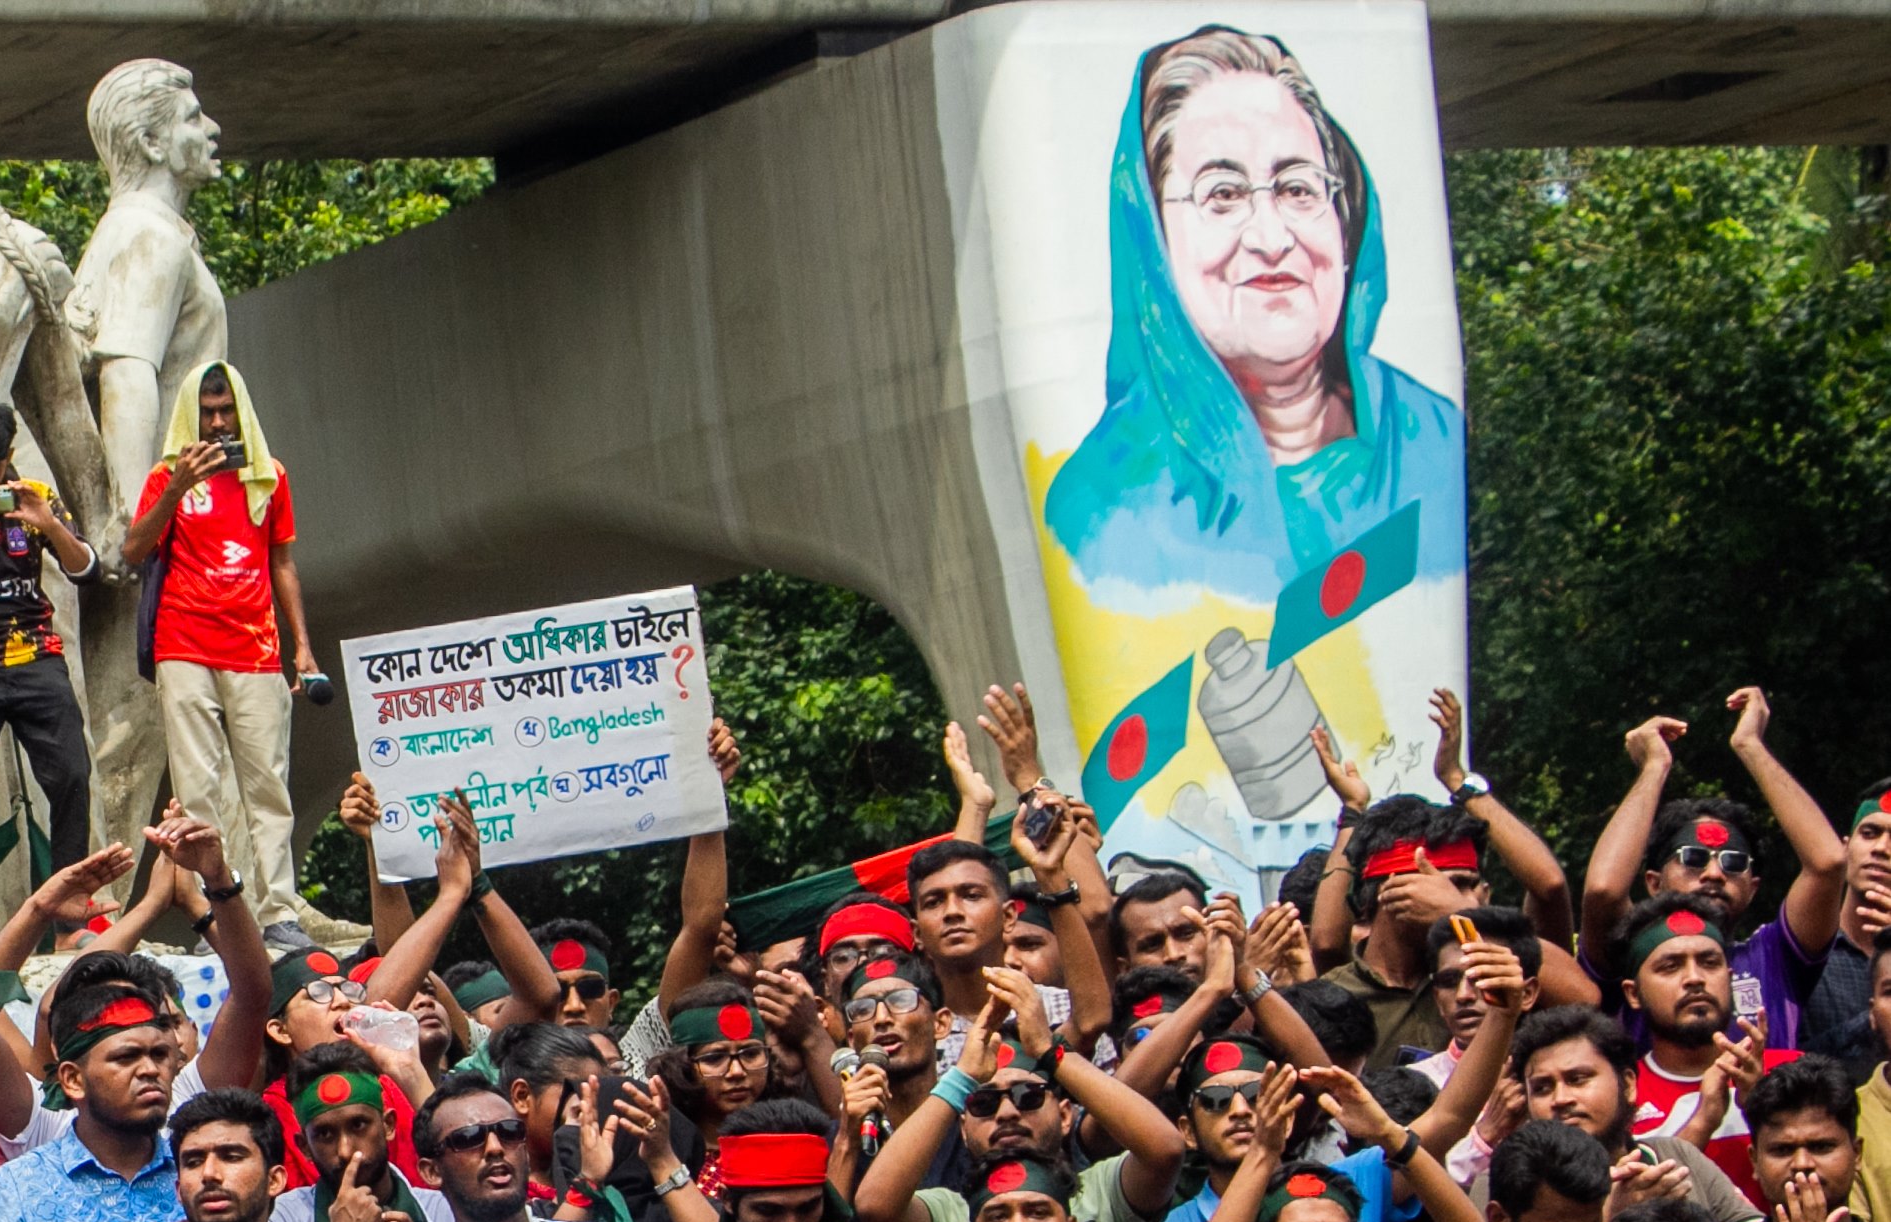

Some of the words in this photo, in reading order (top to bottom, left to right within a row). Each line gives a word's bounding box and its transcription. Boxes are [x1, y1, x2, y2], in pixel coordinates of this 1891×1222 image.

[360, 647, 422, 684] কোন
[428, 638, 496, 674] দেশে
[503, 617, 607, 664] অধিকার
[611, 606, 695, 649] চাইলে
[372, 678, 486, 725] রাজাকার
[624, 652, 667, 686] হয়
[400, 725, 495, 758] বাংলাদেশ
[548, 705, 665, 744] Bangladesh
